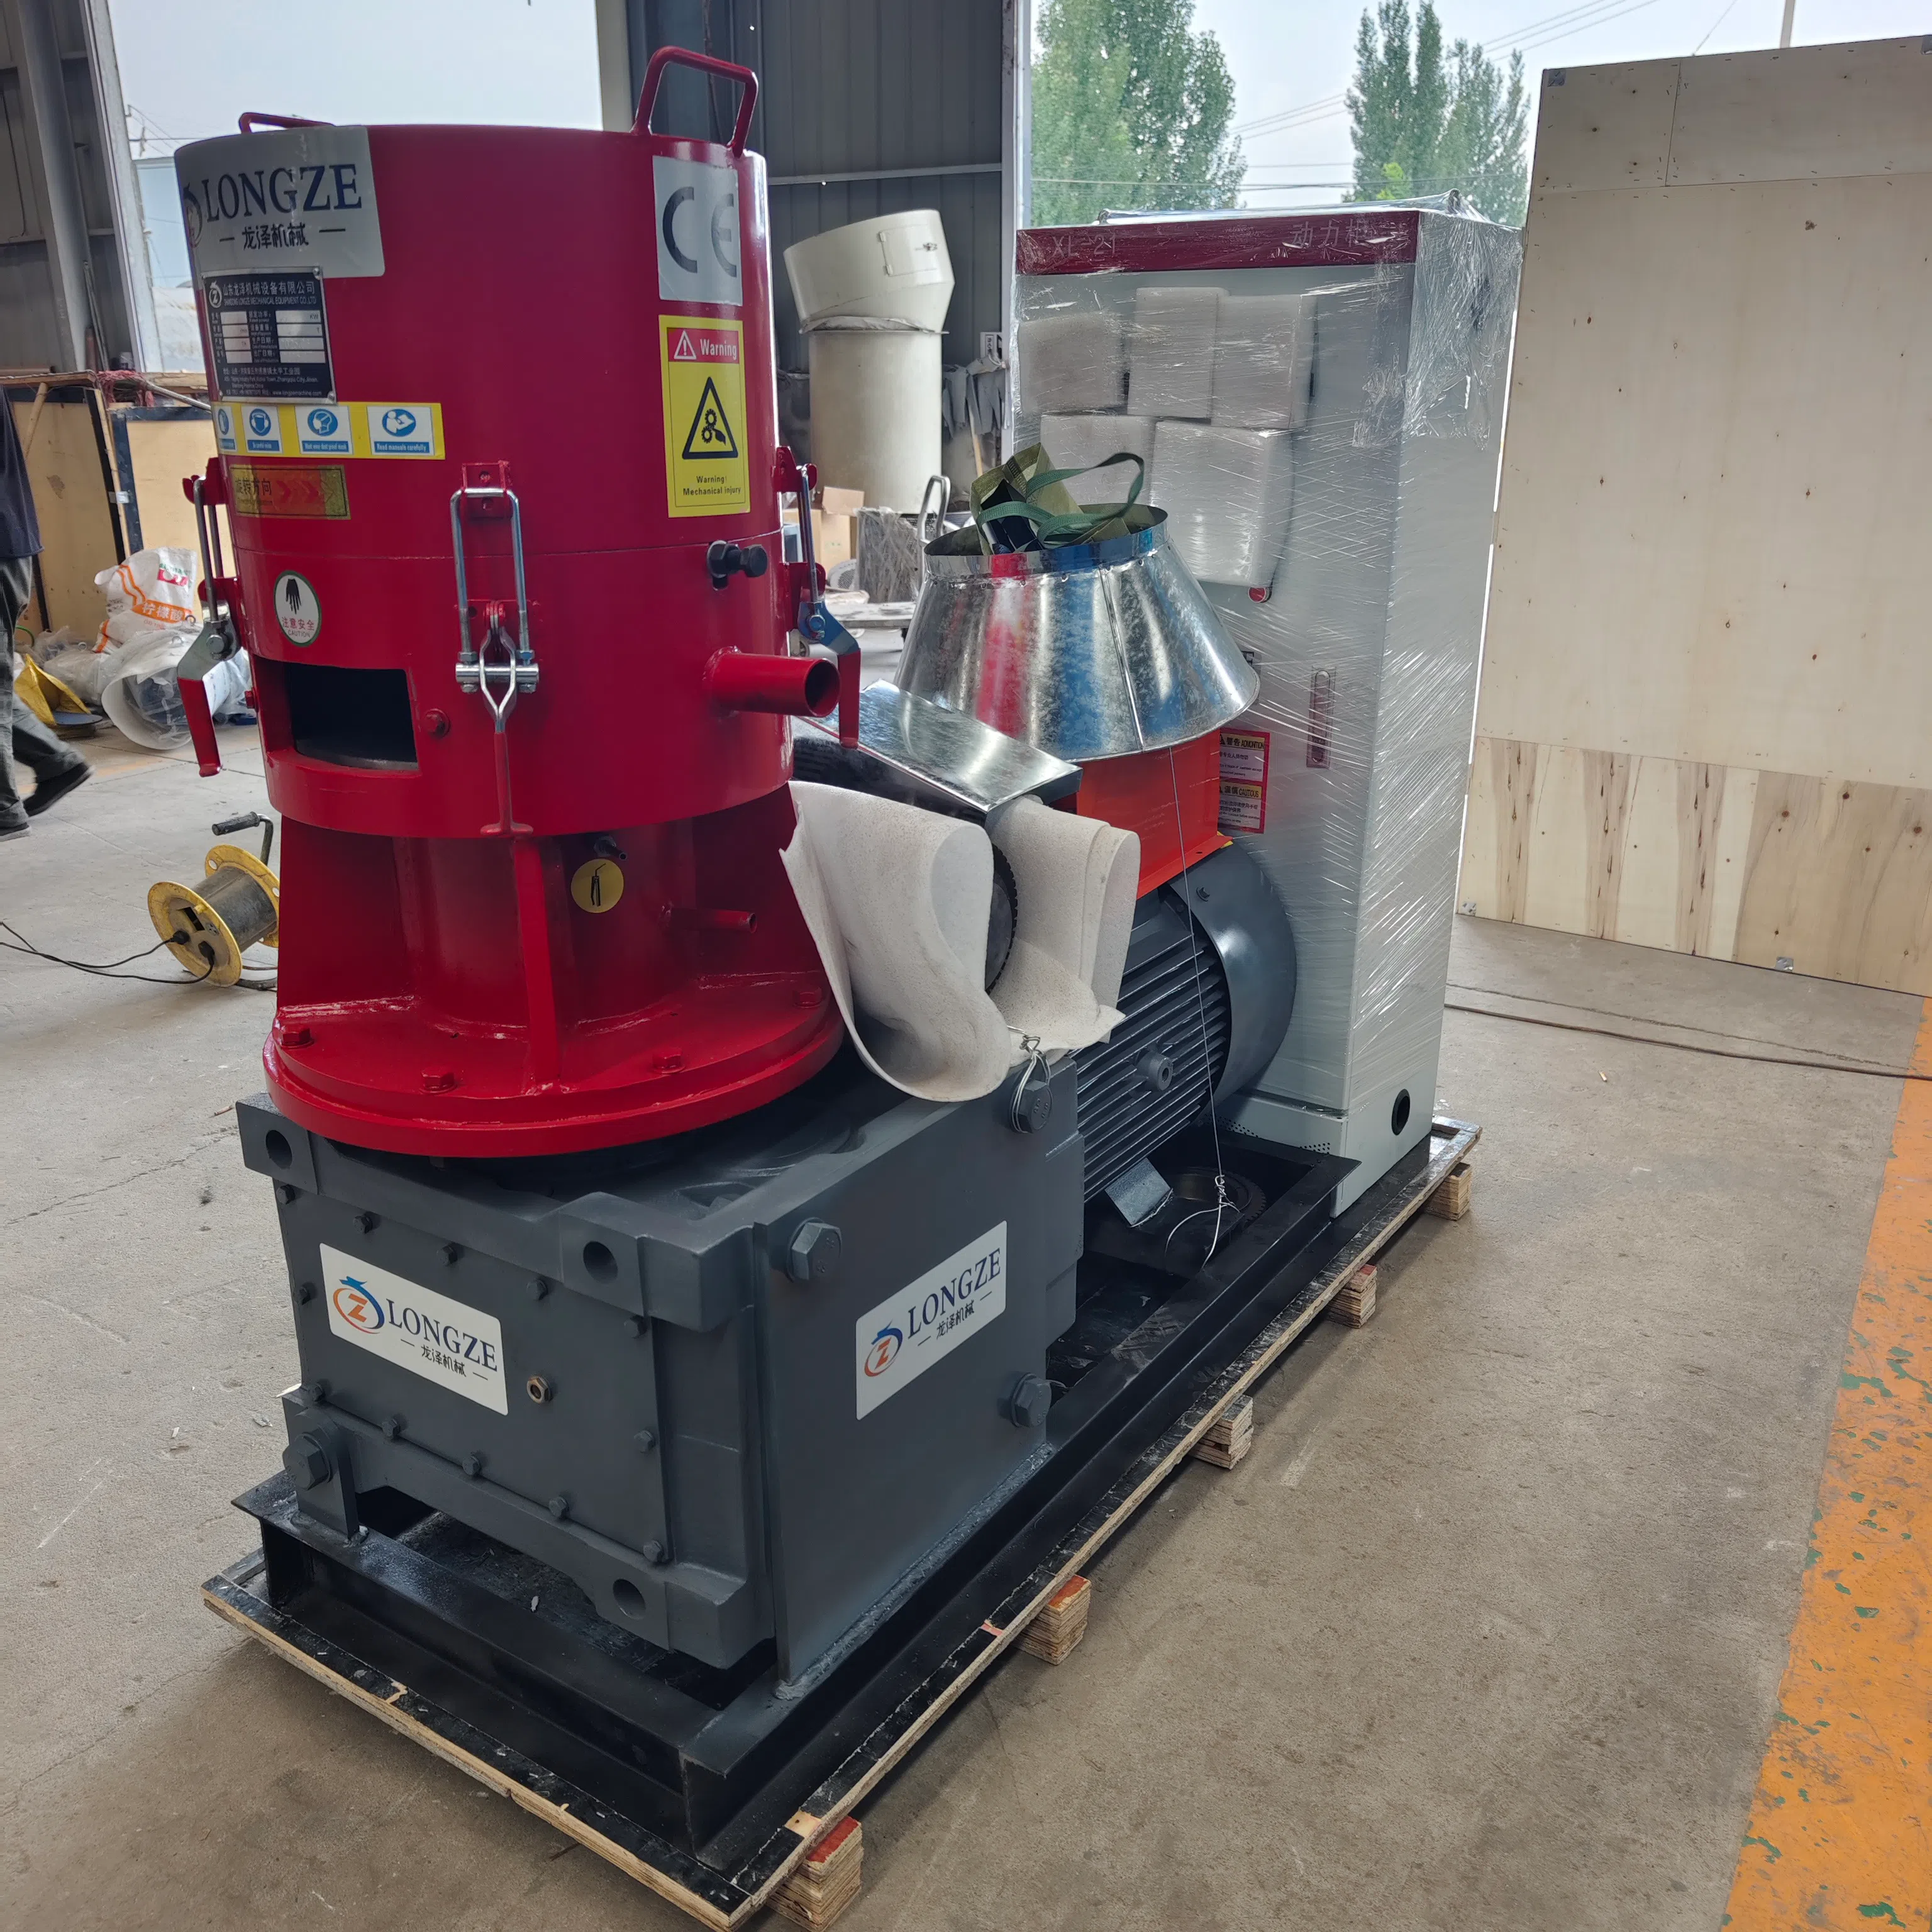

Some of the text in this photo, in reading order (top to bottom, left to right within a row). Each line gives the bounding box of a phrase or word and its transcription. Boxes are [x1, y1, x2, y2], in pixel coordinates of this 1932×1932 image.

[201, 164, 362, 223] LONGZE
[242, 222, 309, 250] 龙泽机械
[662, 186, 737, 278] CE
[223, 281, 316, 297] 山东龙泽机械设备有限公司
[700, 338, 737, 360] Warning
[683, 485, 741, 496] Mechanical injury
[281, 616, 314, 631] 注意安全
[287, 629, 311, 638] CAUTION
[908, 1248, 1001, 1340] LONGZE
[936, 1299, 975, 1340] 龙泽机械
[386, 1298, 497, 1372] LONGZE
[421, 1345, 467, 1377] 龙泽机械
